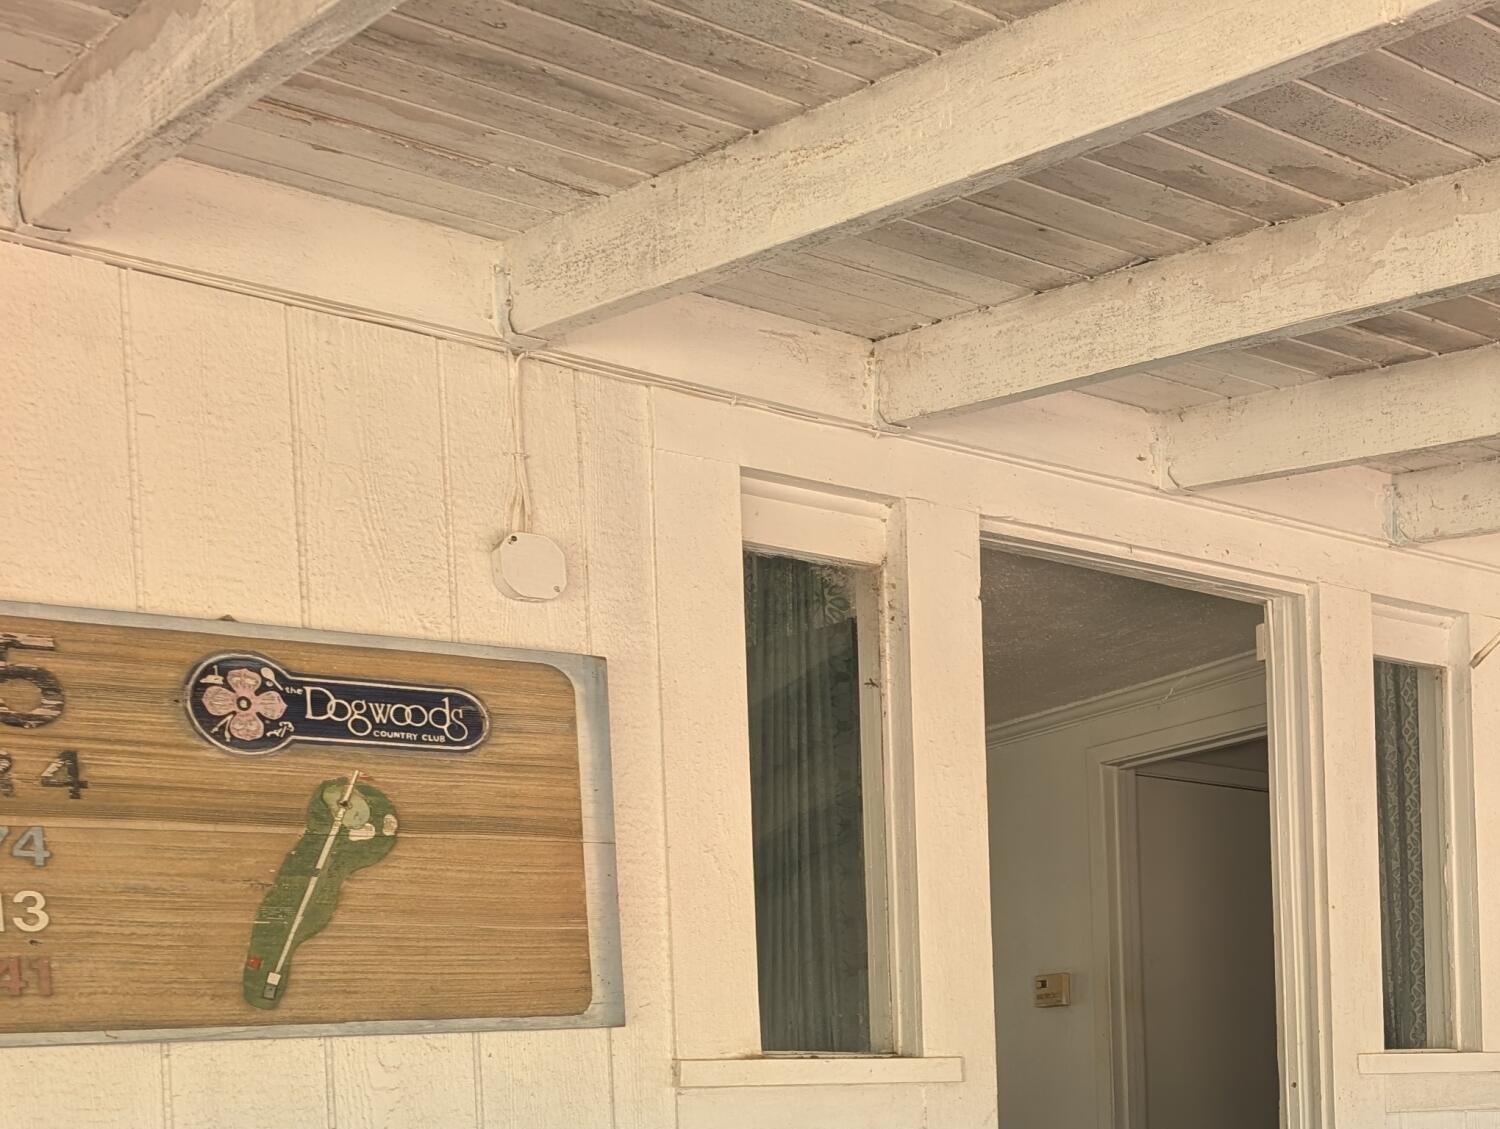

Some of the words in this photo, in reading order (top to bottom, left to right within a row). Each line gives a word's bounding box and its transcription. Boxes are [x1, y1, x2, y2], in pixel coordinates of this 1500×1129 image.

[285, 686, 303, 695] the
[303, 686, 469, 742] Dogwoods
[373, 730, 418, 742] COUNTRY
[421, 734, 447, 743] CLUB
[40, 751, 88, 799] 4
